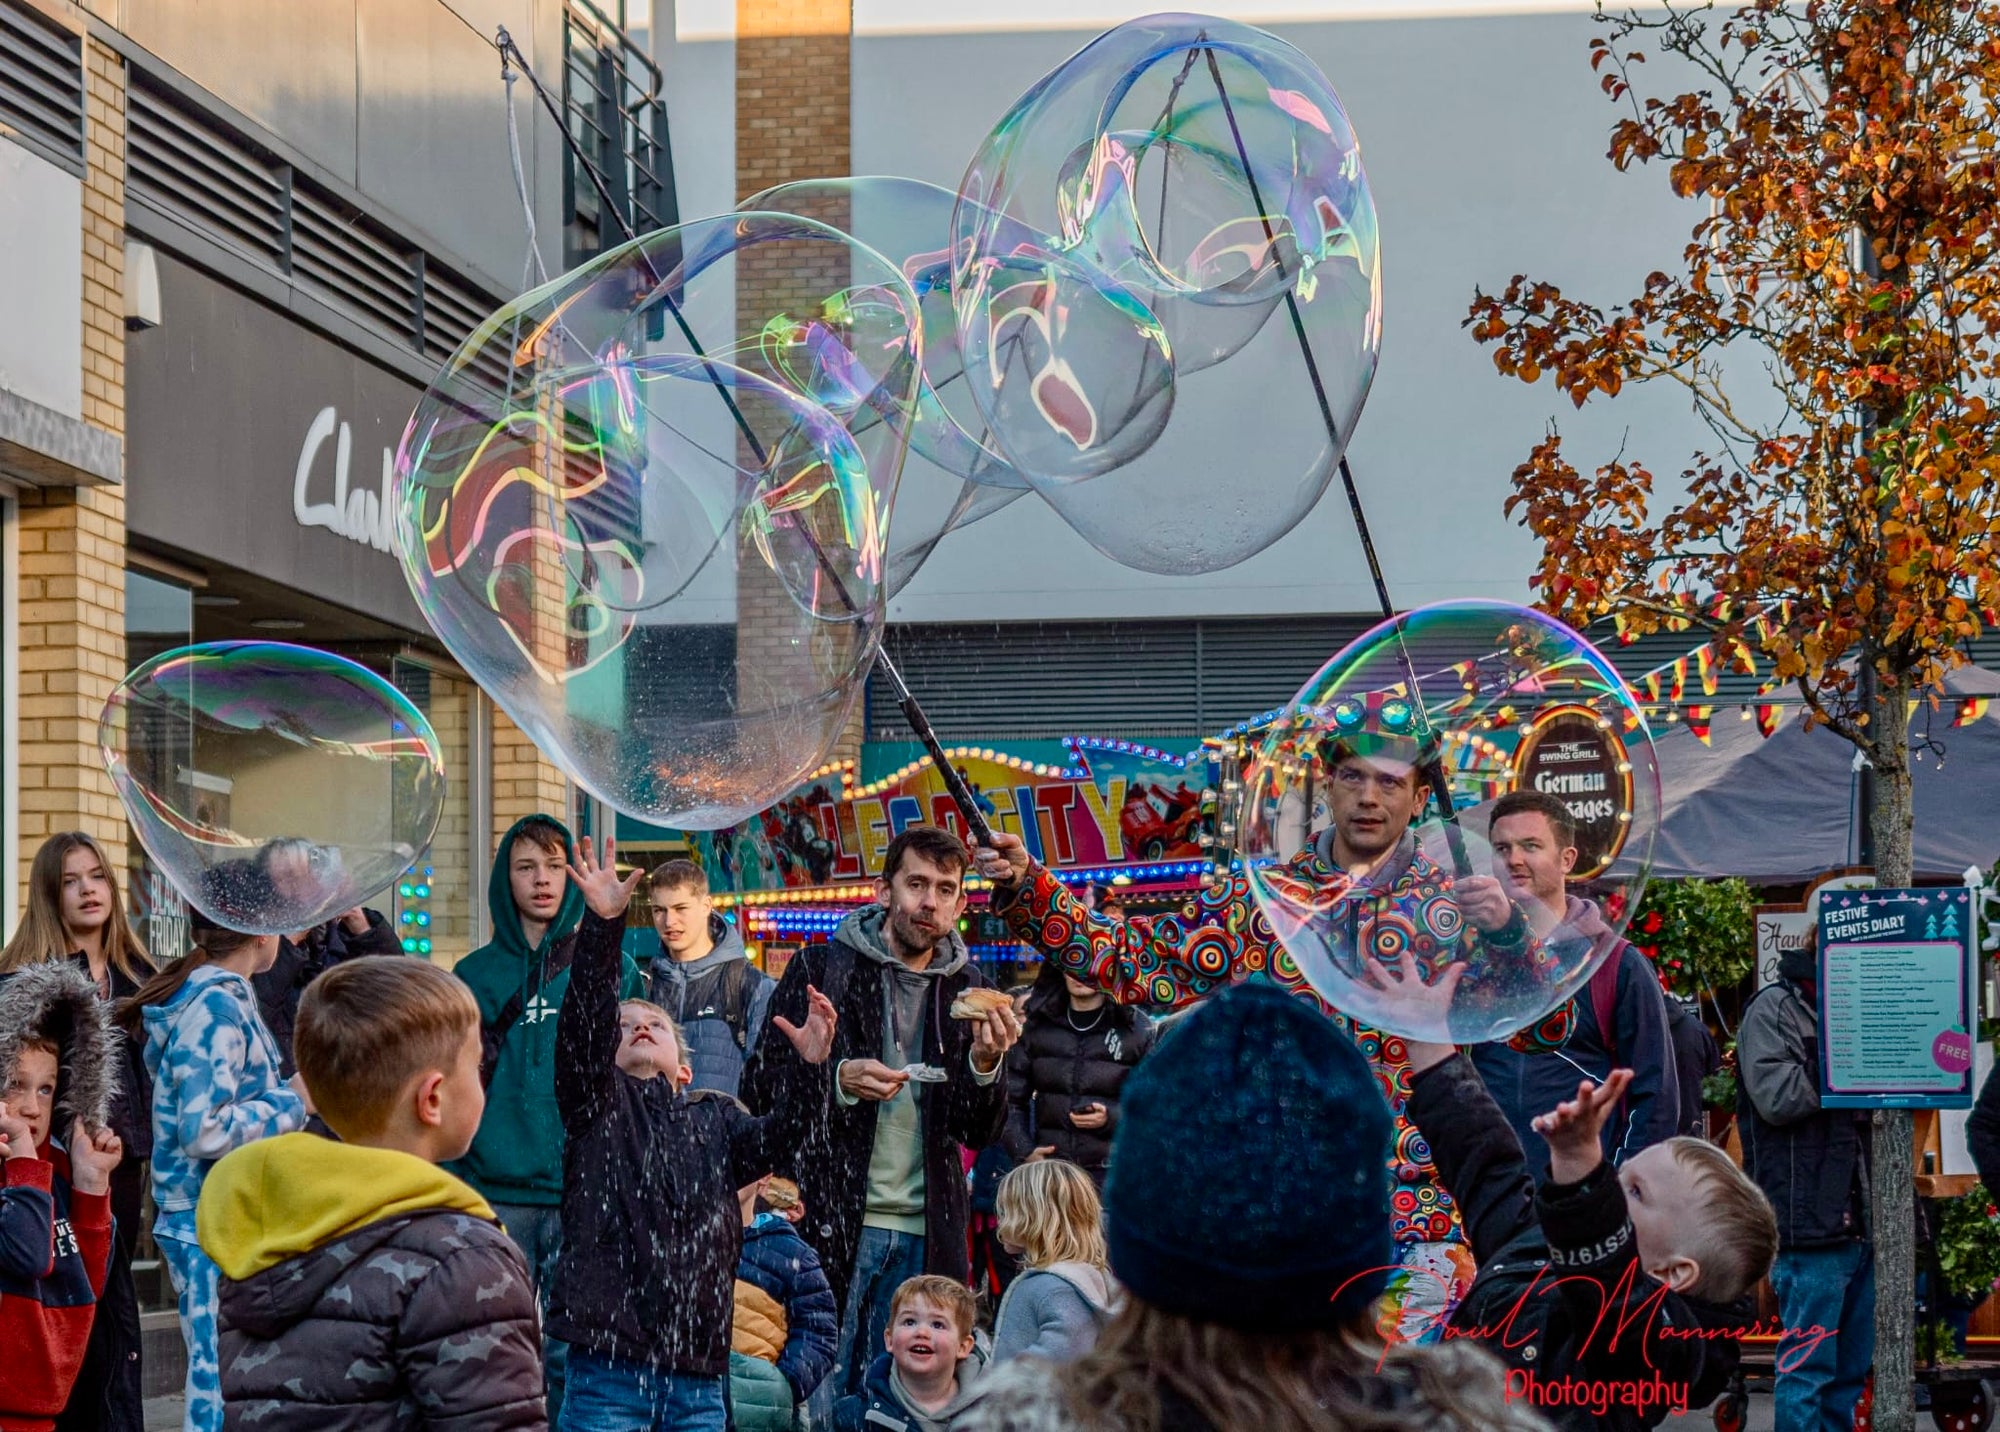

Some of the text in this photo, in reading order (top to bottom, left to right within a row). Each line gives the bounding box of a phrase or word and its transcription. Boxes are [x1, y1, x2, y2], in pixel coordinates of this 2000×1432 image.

[1539, 749, 1600, 762] SWING GRILL
[1559, 743, 1579, 752] THE
[1534, 770, 1606, 794] German
[1825, 905, 1869, 924] FESTIVE
[149, 914, 185, 958] FRIDAY
[1826, 921, 1870, 940] EVENTS
[1871, 914, 1905, 932] DIARY
[1938, 1043, 1969, 1060] FREE
